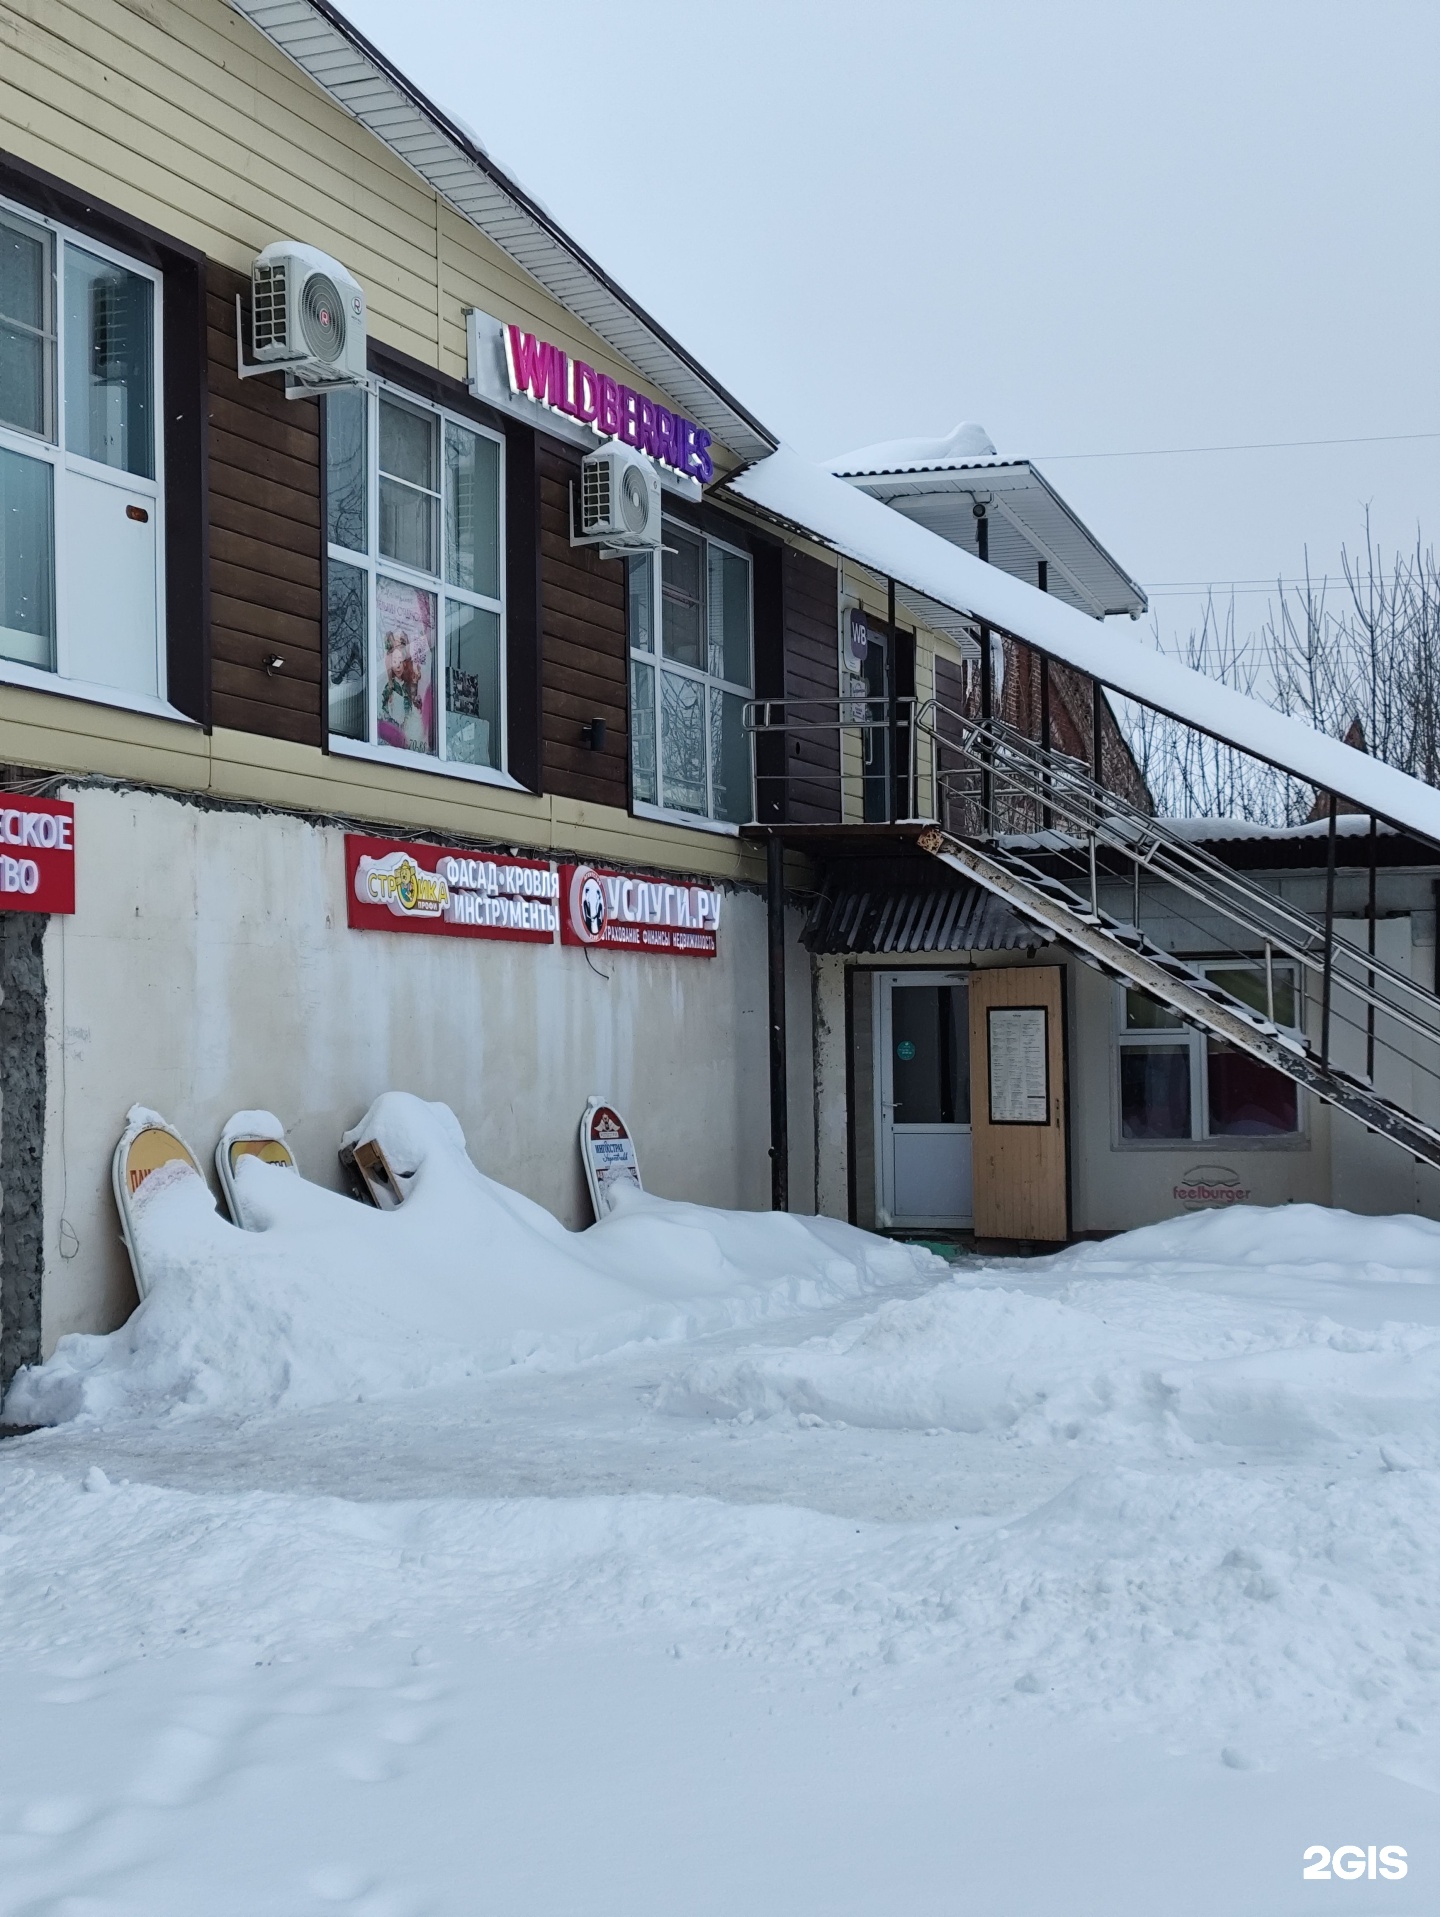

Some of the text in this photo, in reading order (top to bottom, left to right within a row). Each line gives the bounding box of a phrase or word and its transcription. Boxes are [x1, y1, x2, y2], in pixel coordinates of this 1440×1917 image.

[505, 324, 714, 484] WILDBERRIES
[851, 621, 867, 646] WB
[417, 900, 439, 911] ПРОФИ
[454, 893, 560, 931] ИНСТРУМЕНТЫ
[606, 878, 721, 931] УСЛУГИ.РУ
[642, 929, 671, 947] ФИНАНСЫ
[672, 930, 715, 950] НЕДВИЖИМОСТЬ
[1173, 1185, 1252, 1203] feelburger
